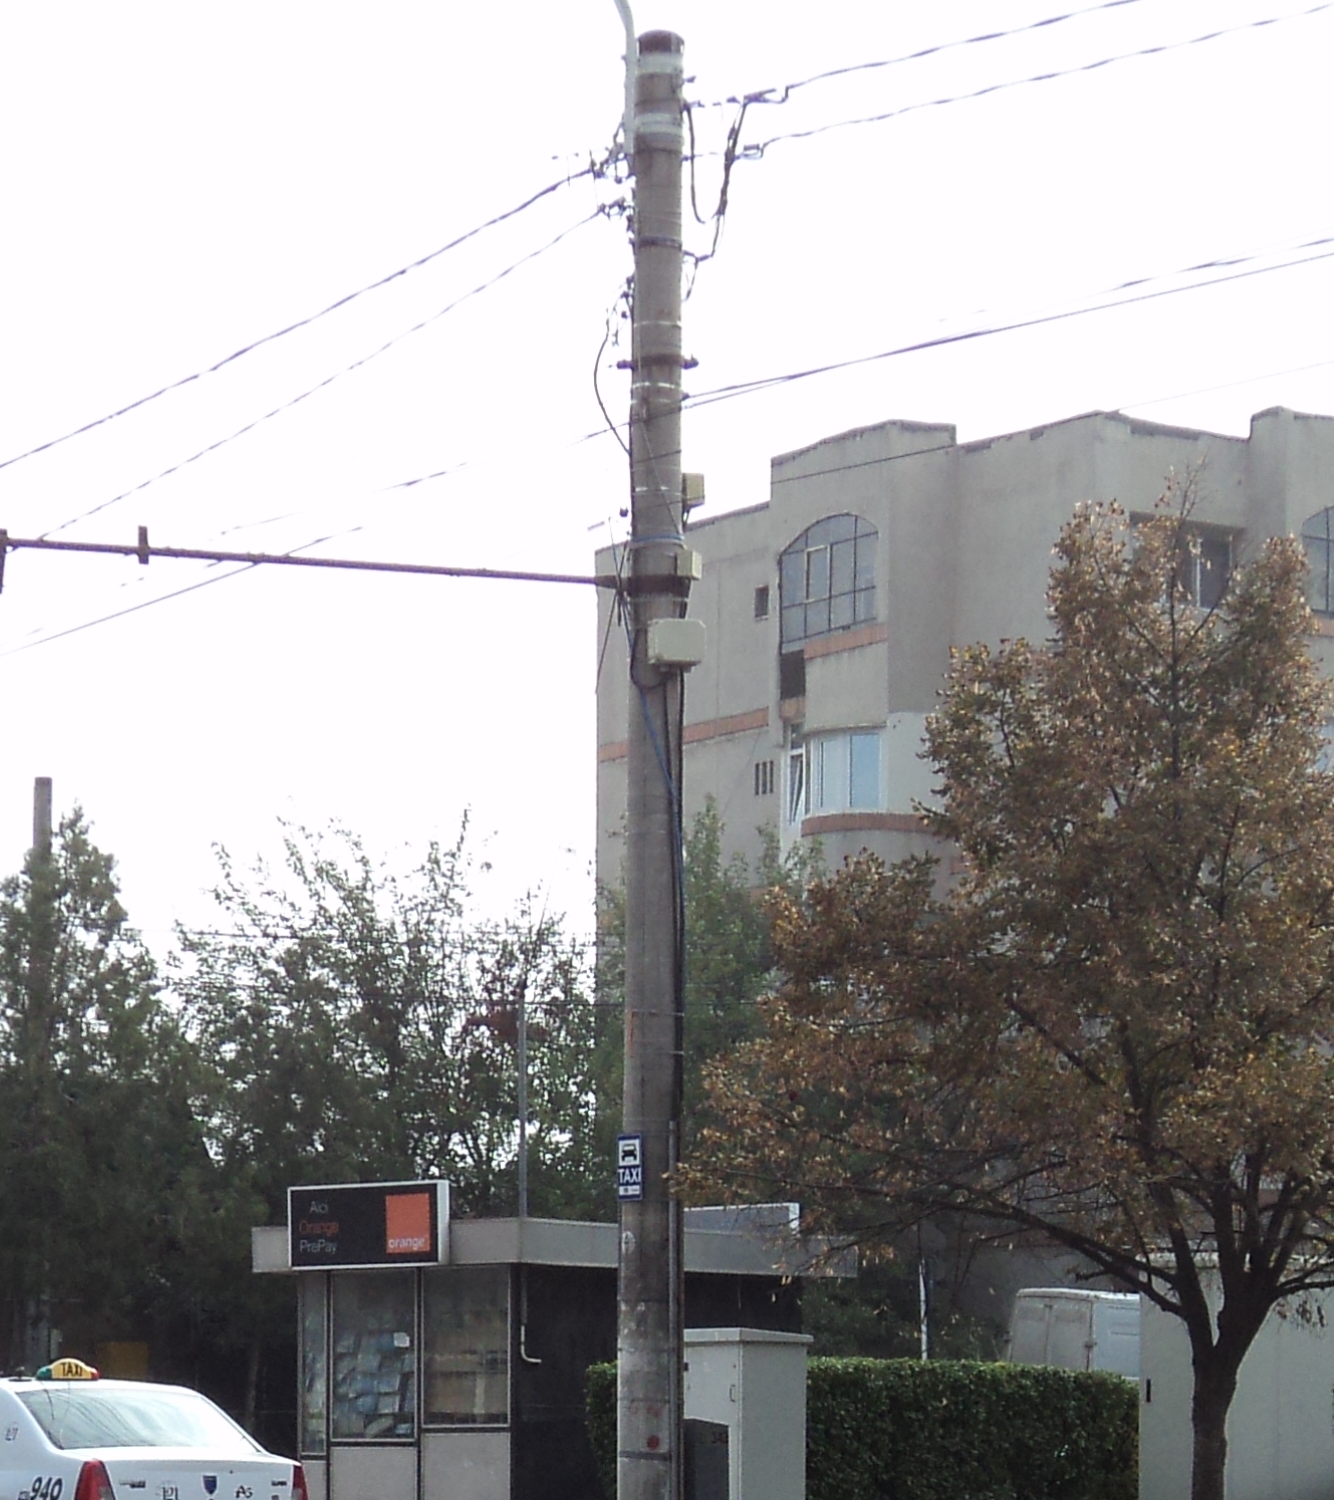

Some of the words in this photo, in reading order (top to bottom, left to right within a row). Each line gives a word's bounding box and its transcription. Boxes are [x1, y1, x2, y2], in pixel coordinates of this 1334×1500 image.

[617, 1167, 642, 1184] TAXI
[299, 1220, 340, 1237] Orange
[299, 1239, 338, 1255] PrePay
[387, 1237, 425, 1251] orange
[60, 1362, 83, 1378] TAXI
